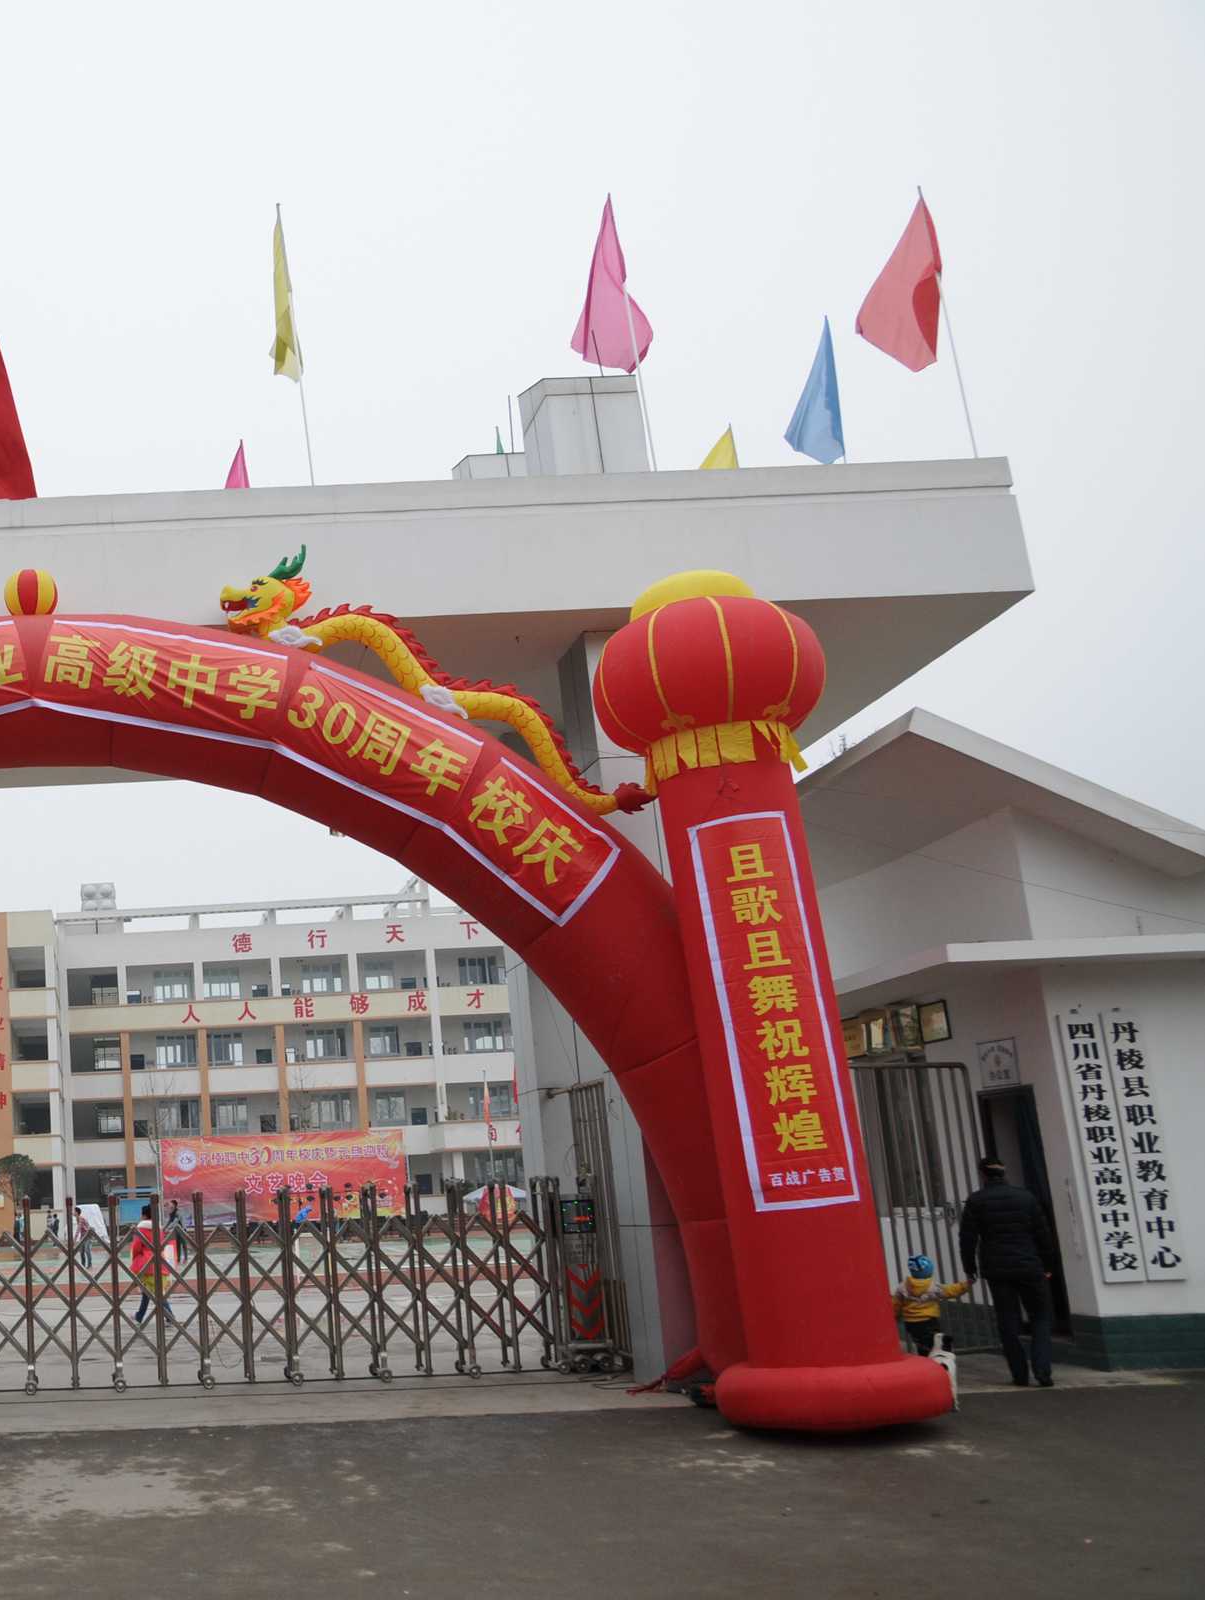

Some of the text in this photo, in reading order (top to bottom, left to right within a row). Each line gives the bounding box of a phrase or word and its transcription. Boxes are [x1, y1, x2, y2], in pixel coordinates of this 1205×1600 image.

[182, 989, 485, 1024] 人人能够成才
[232, 920, 478, 953] 德行天下
[726, 843, 828, 1153] 且歌且舞祝辉煌
[244, 1170, 328, 1194] 文艺晚会
[1067, 1023, 1139, 1271] 四川省丹棱职业高级中学校
[1110, 1021, 1182, 1268] 丹棱县职业教育中心
